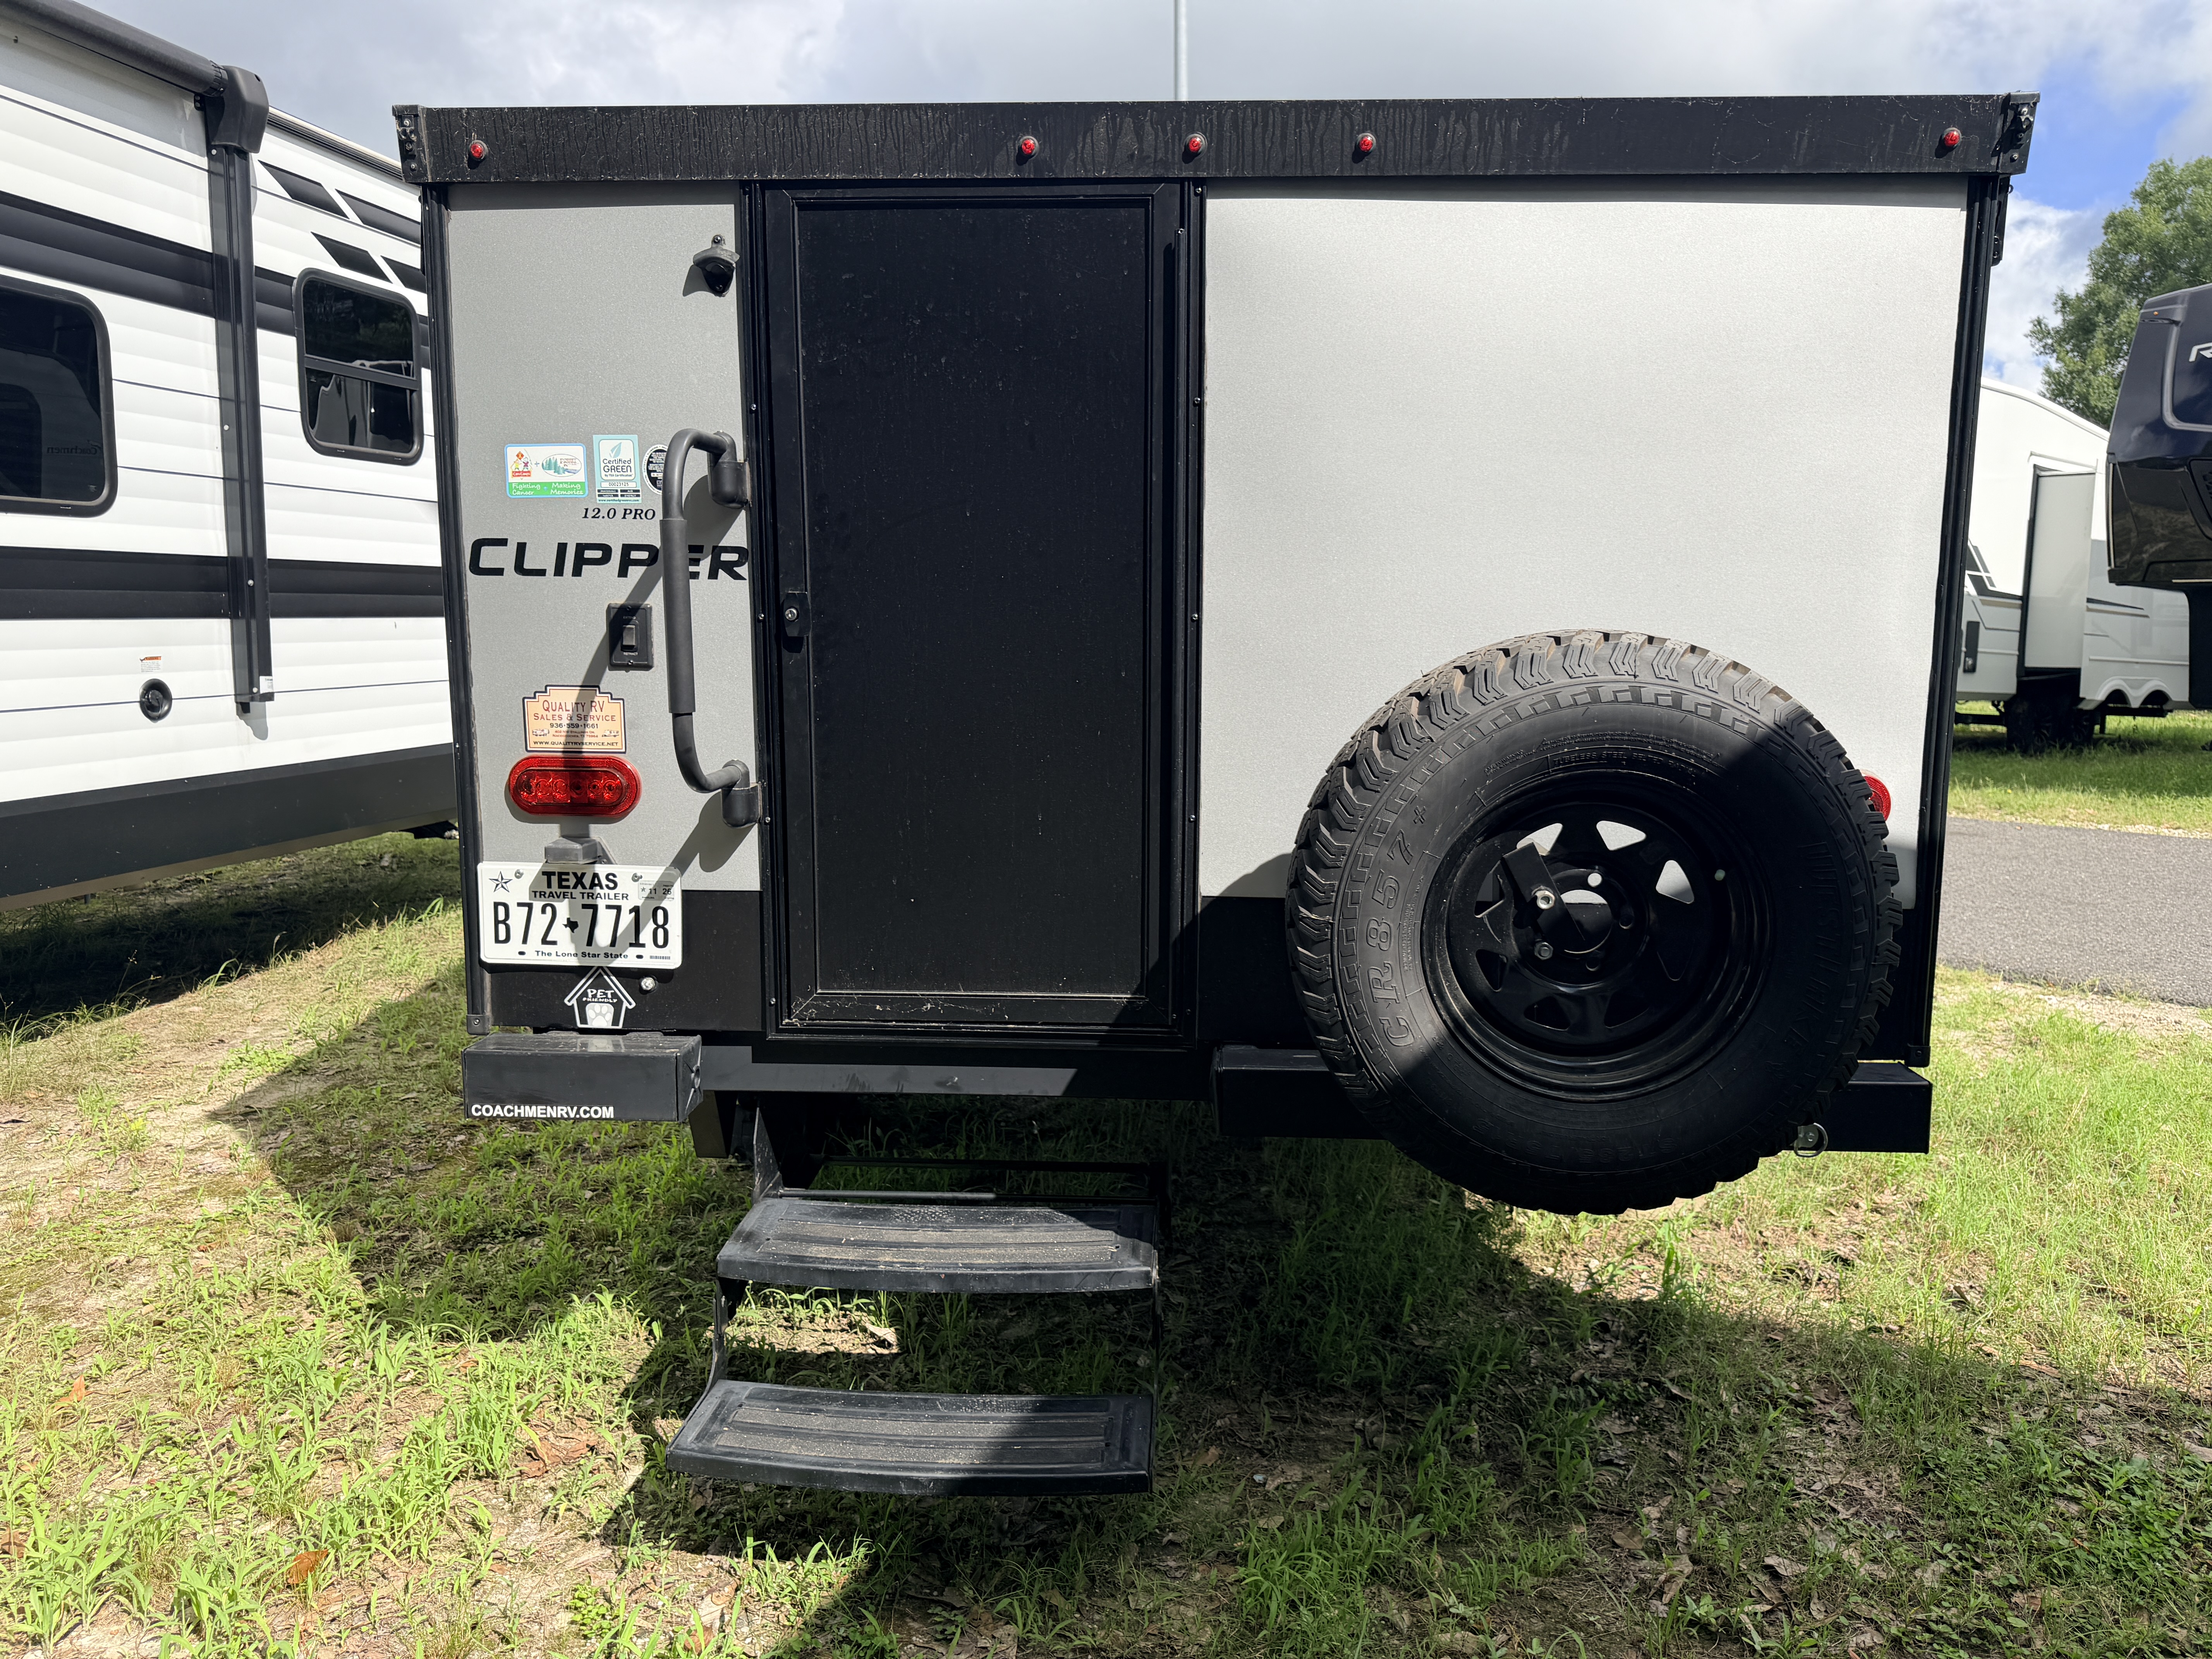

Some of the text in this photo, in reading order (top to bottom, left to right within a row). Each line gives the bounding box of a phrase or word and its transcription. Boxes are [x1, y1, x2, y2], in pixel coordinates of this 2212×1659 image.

[581, 507, 656, 520] 12.0 PRO
[590, 701, 605, 712] RV
[542, 871, 618, 890] TEXAS
[532, 891, 629, 901] TRAVEL TRAILER
[587, 989, 614, 999] PET
[471, 1104, 614, 1118] COACHMENRV.COM
